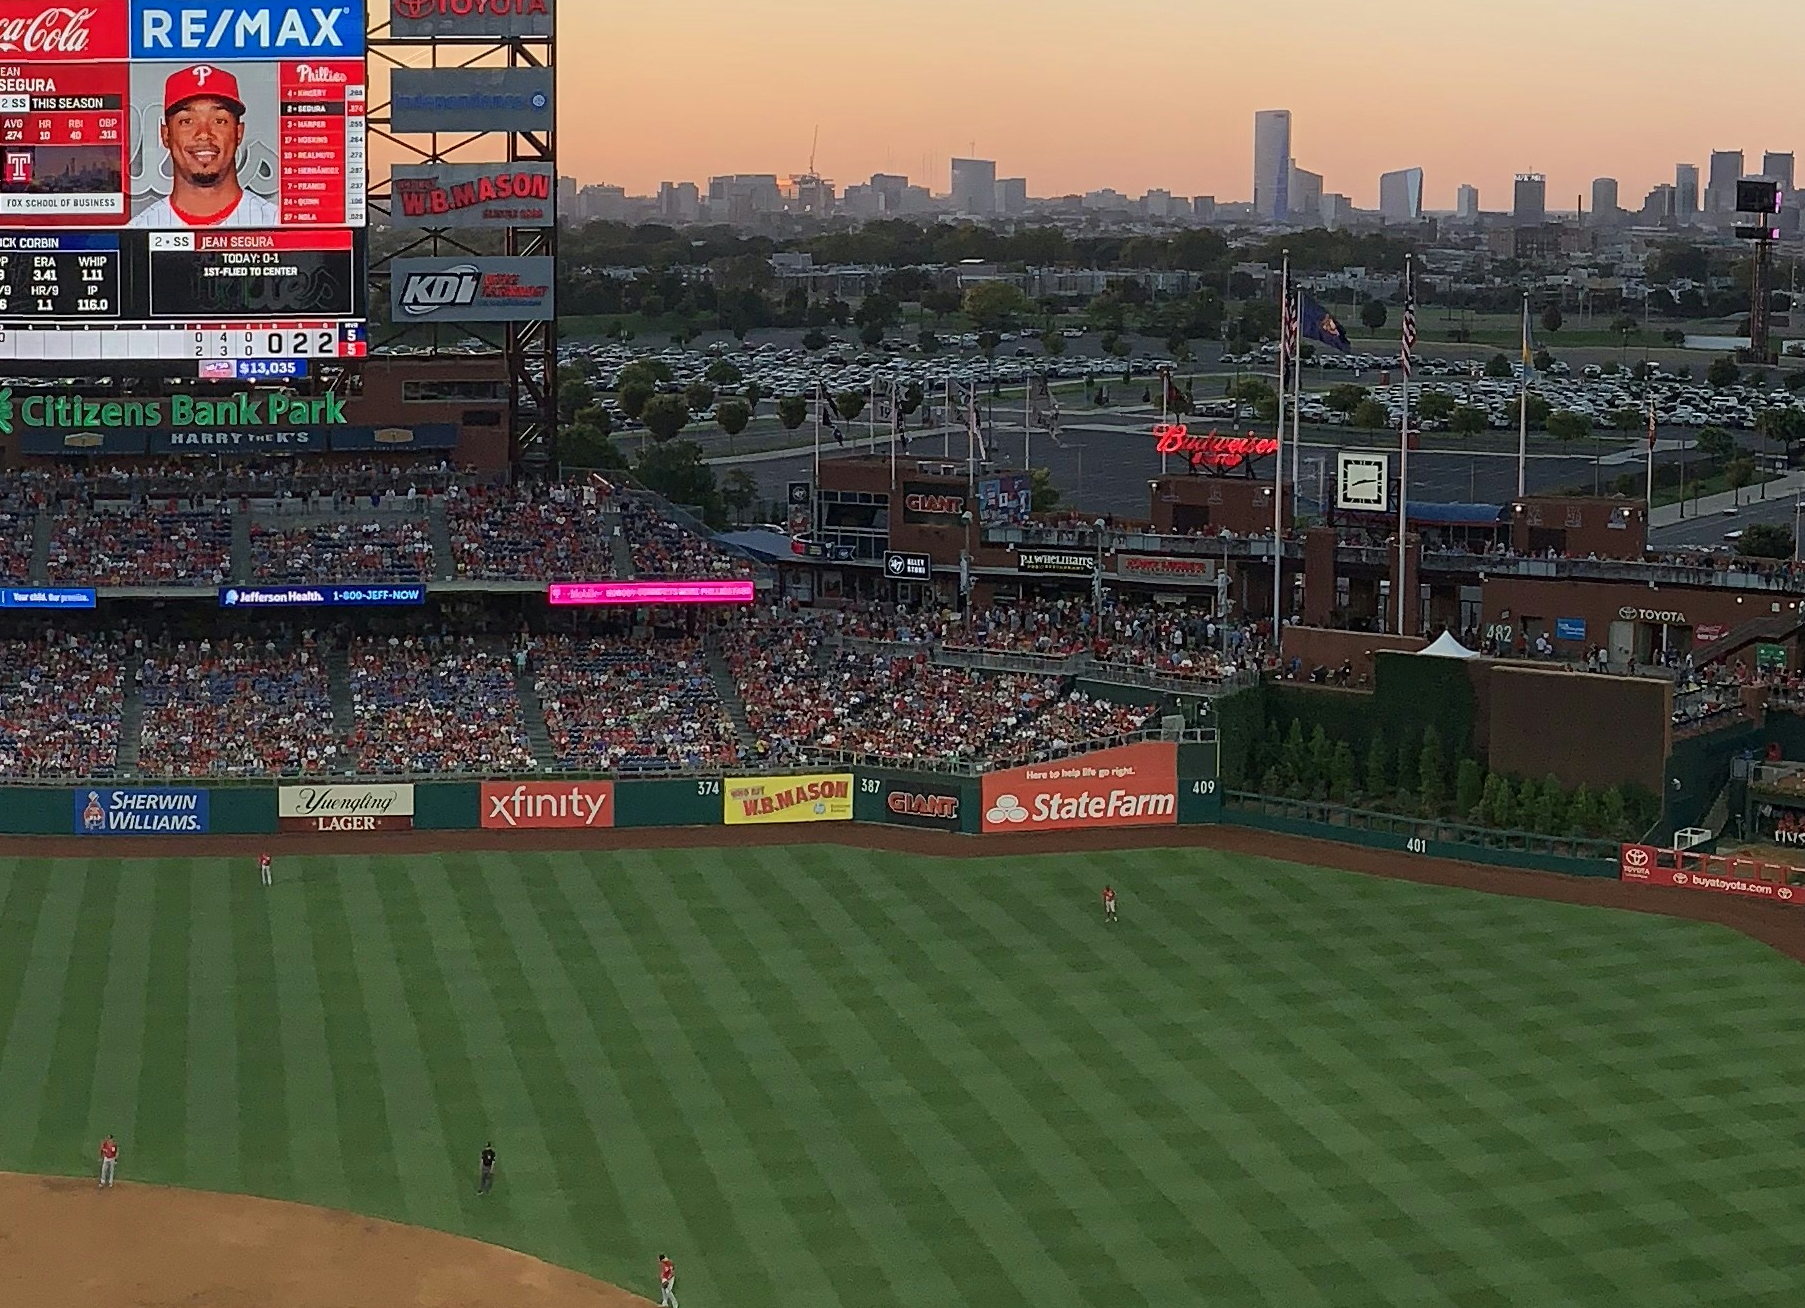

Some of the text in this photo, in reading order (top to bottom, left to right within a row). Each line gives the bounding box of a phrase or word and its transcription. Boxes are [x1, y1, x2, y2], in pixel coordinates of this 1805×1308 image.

[143, 9, 343, 47] RE/MAX
[12, 99, 26, 108] SS
[32, 99, 57, 109] THIS
[59, 98, 103, 108] SEASON
[20, 238, 59, 248] CORBIN
[174, 237, 189, 247] SS
[201, 237, 227, 249] JEAN
[231, 237, 274, 247] SEGURA
[34, 257, 56, 267] ERA
[79, 257, 107, 267] WHIP
[223, 253, 279, 264] TODAY: 0-1
[33, 270, 57, 281] 3.41
[82, 270, 103, 281] 1.11
[31, 286, 59, 296] HR/9
[88, 286, 97, 295] IP
[37, 299, 53, 310] 1.1
[77, 299, 108, 311] 116.0
[239, 362, 296, 375] $13,035
[21, 390, 348, 427] Citizens Bank Park
[1153, 424, 1279, 454] Budweiser
[906, 493, 965, 514] GIANT
[240, 592, 287, 602] Jefferson
[288, 592, 324, 601] Health.
[1639, 608, 1685, 623] TOYOTA
[1026, 765, 1136, 780] Here to help life go right.
[698, 781, 720, 797] 374
[860, 778, 881, 795] 387
[1192, 780, 1215, 794] 409
[110, 791, 197, 811] SHERWIN
[296, 787, 397, 815] Yuengling
[490, 785, 606, 826] xfinity
[888, 791, 958, 819] GIANT
[318, 816, 376, 831] LAGER
[1407, 837, 1427, 853] 401
[1692, 874, 1772, 896] buyatoyota.com
